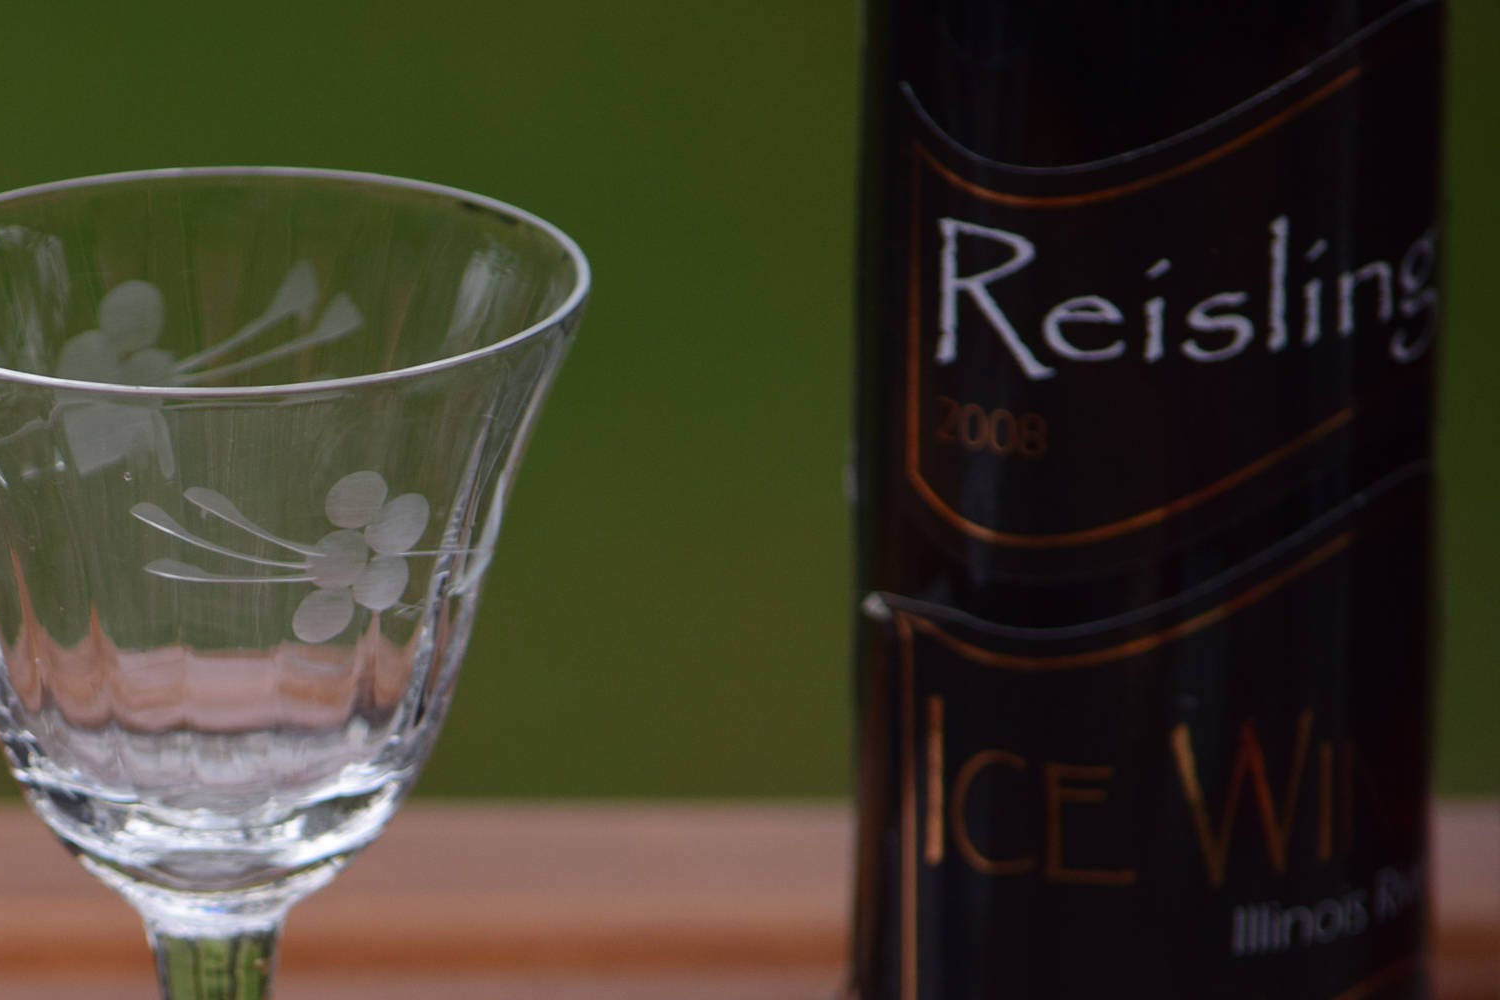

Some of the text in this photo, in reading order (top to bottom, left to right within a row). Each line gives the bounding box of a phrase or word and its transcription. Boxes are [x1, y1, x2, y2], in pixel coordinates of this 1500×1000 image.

[932, 213, 1438, 381] Reisling
[932, 395, 1049, 461] 2008
[923, 694, 1138, 887] ICE
[1231, 884, 1370, 958] Illinois
